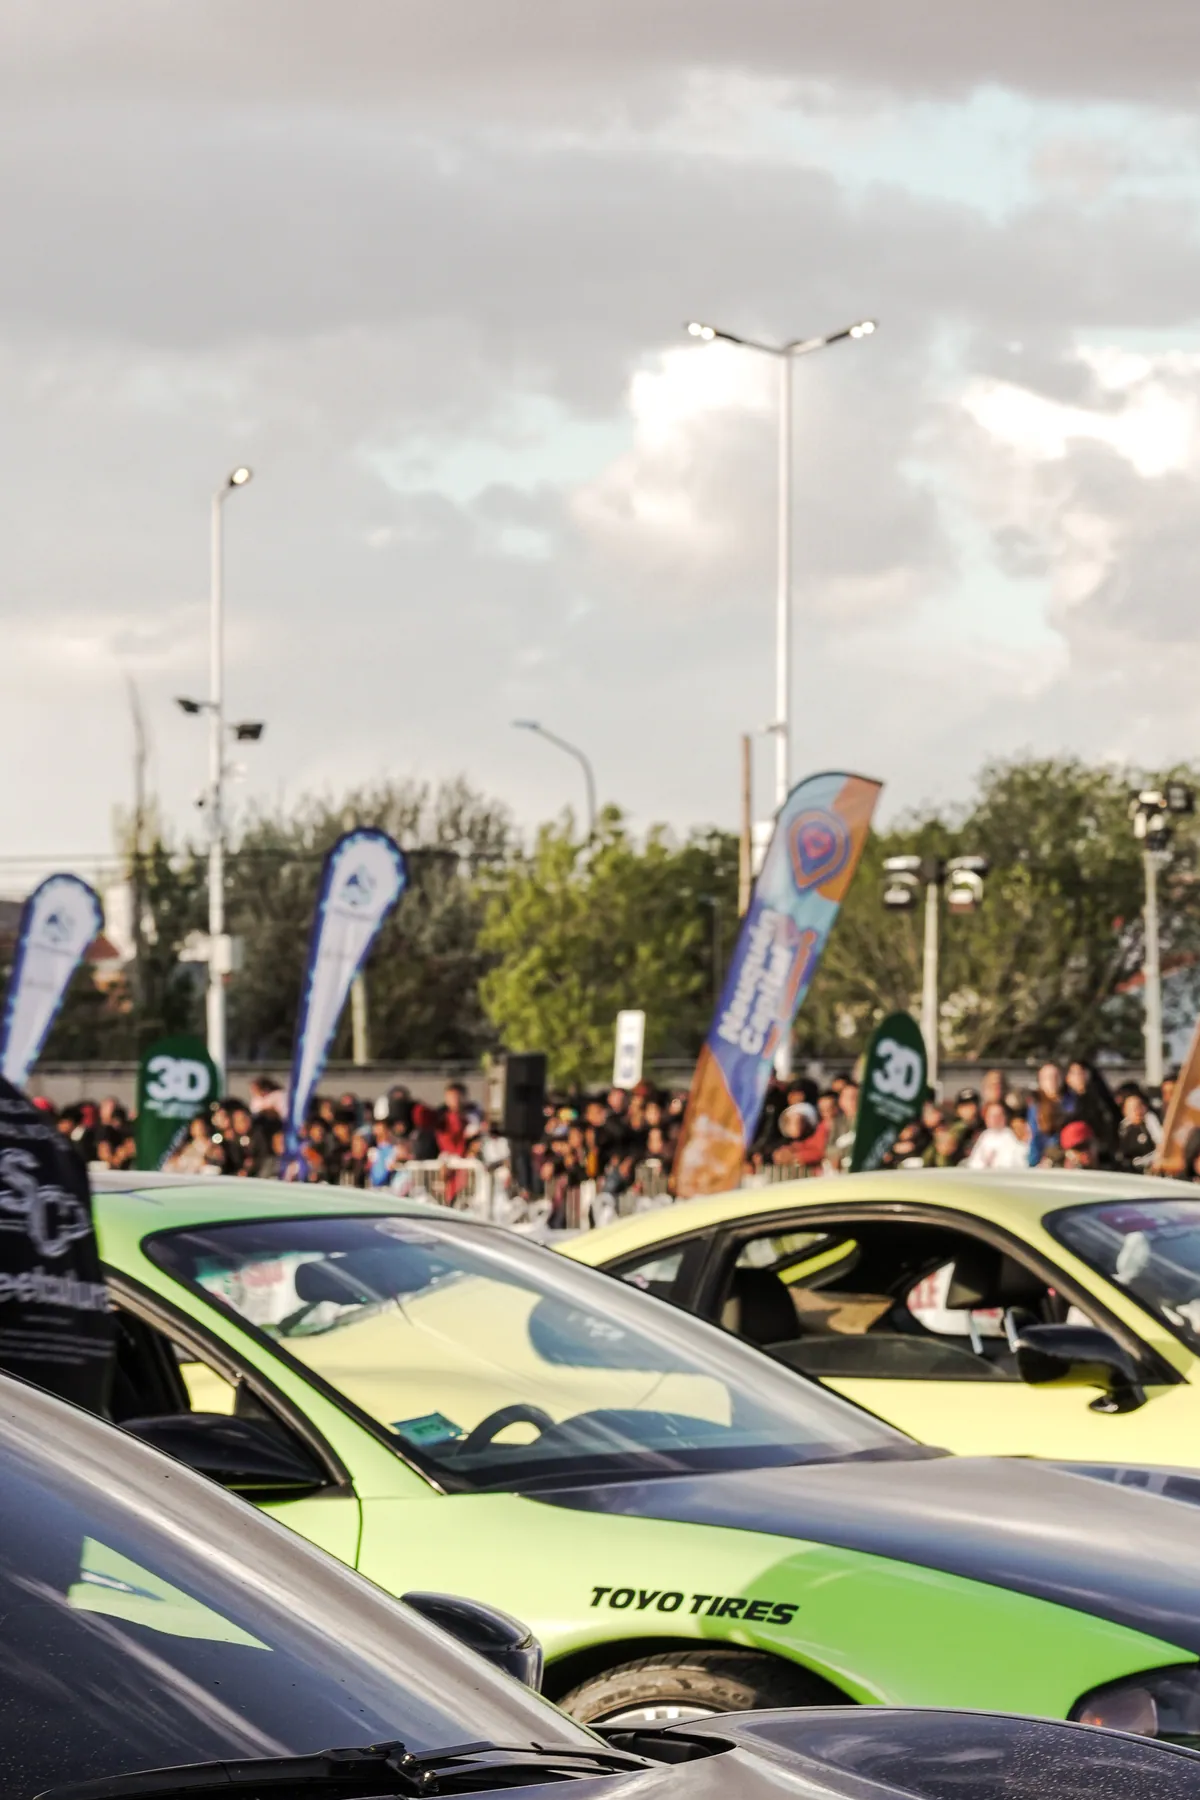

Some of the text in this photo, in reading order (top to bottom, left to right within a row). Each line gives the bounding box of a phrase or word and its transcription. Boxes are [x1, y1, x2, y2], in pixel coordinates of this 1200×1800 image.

[146, 1055, 211, 1102] 3D
[872, 1037, 922, 1101] 3D
[590, 1586, 800, 1625] TOYO TIRES
